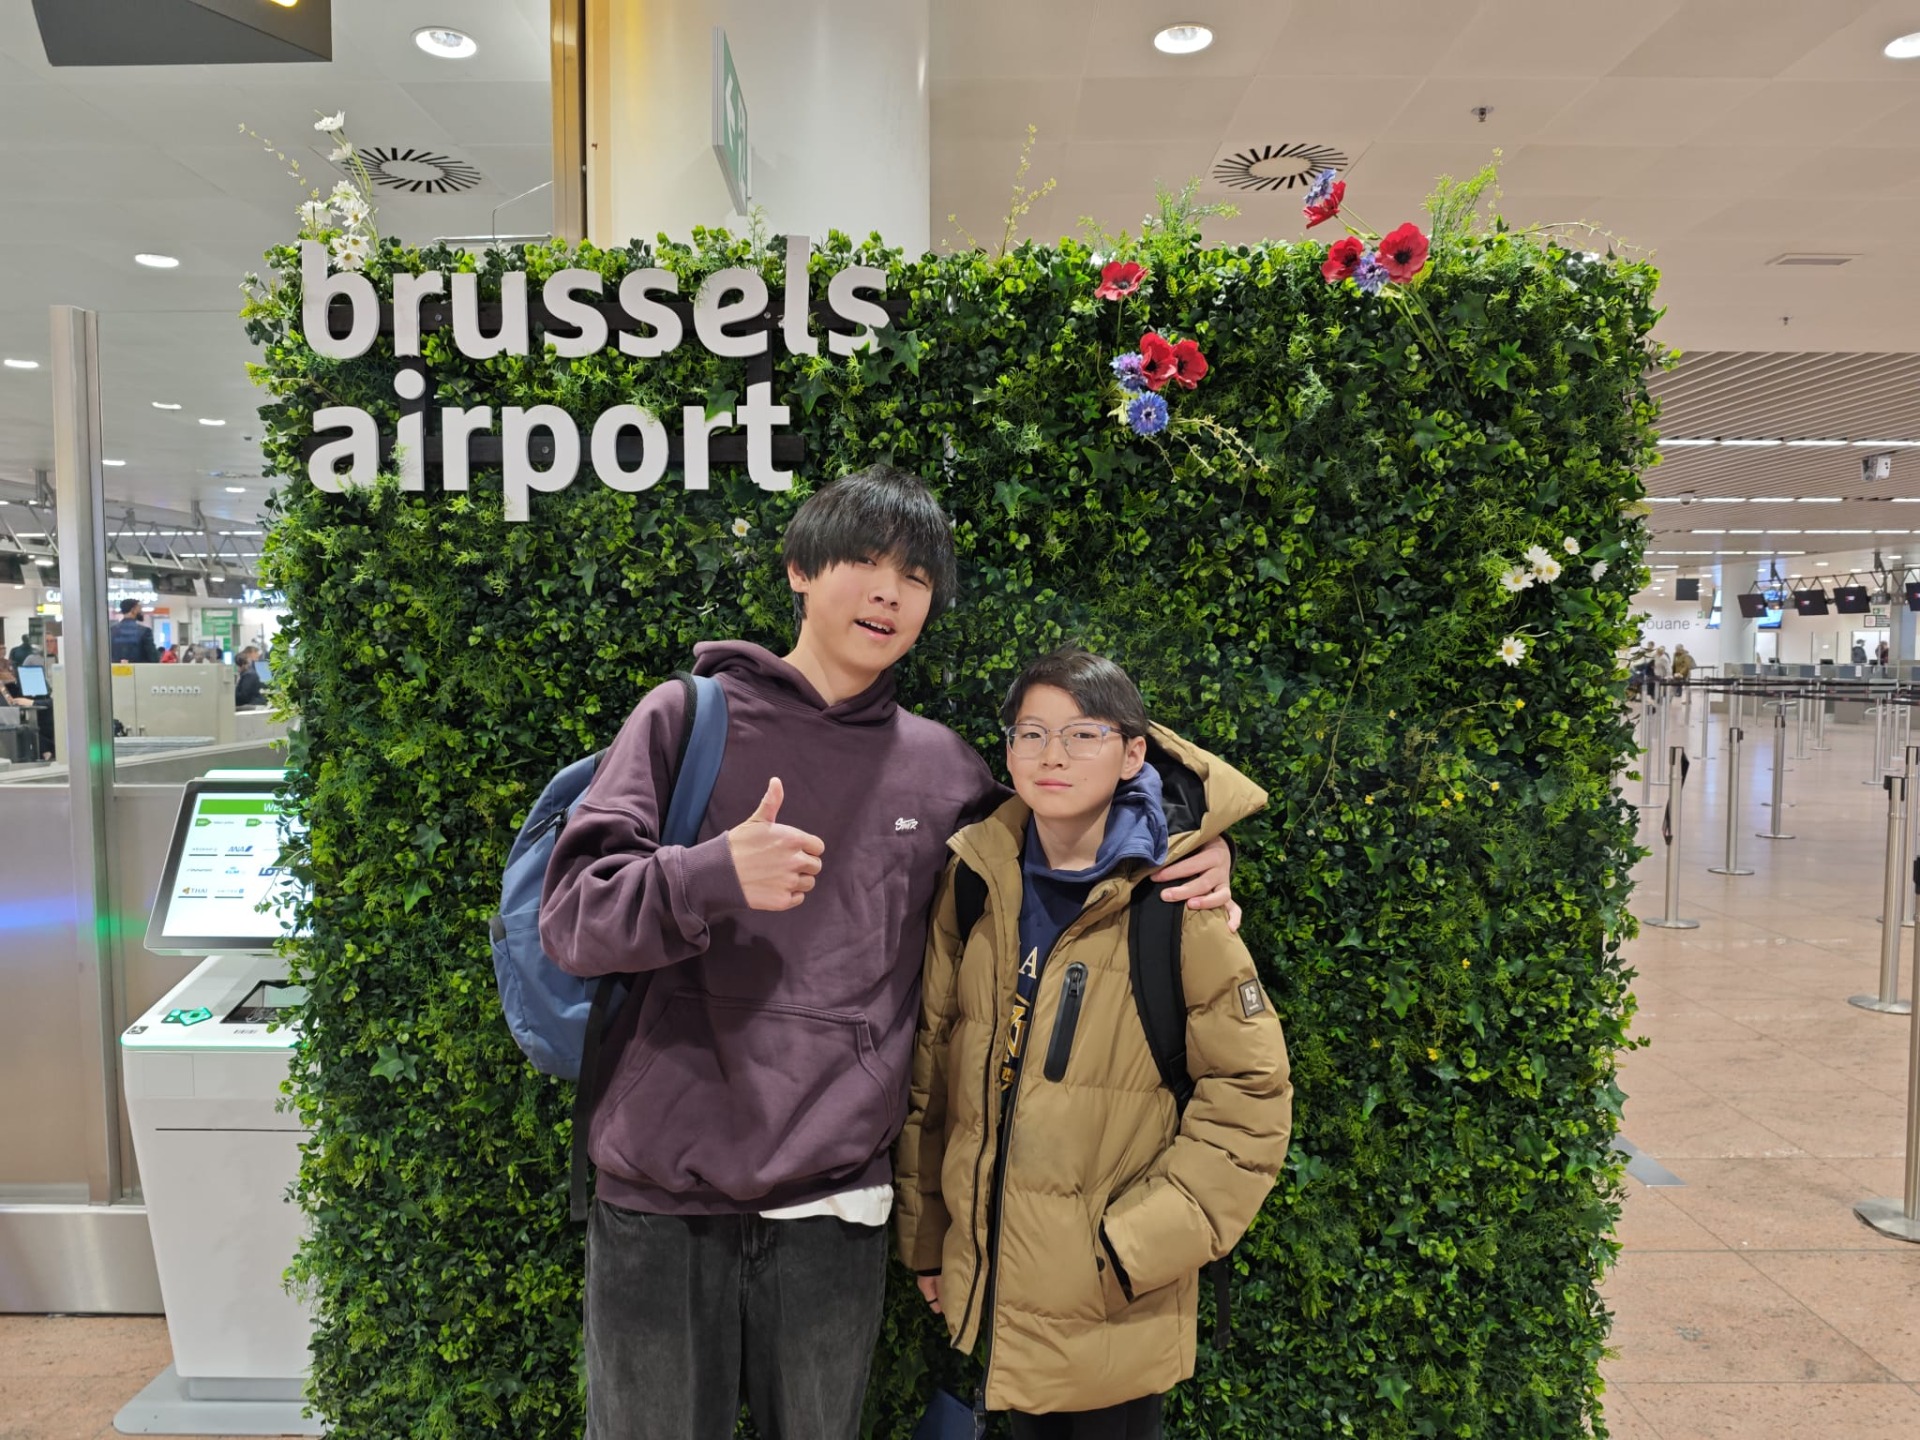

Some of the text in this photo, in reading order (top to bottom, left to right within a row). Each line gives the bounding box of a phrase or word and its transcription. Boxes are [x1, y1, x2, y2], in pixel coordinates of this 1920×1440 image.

[301, 235, 892, 360] brussels
[307, 368, 794, 522] airport
[1642, 618, 1690, 630] ouane
